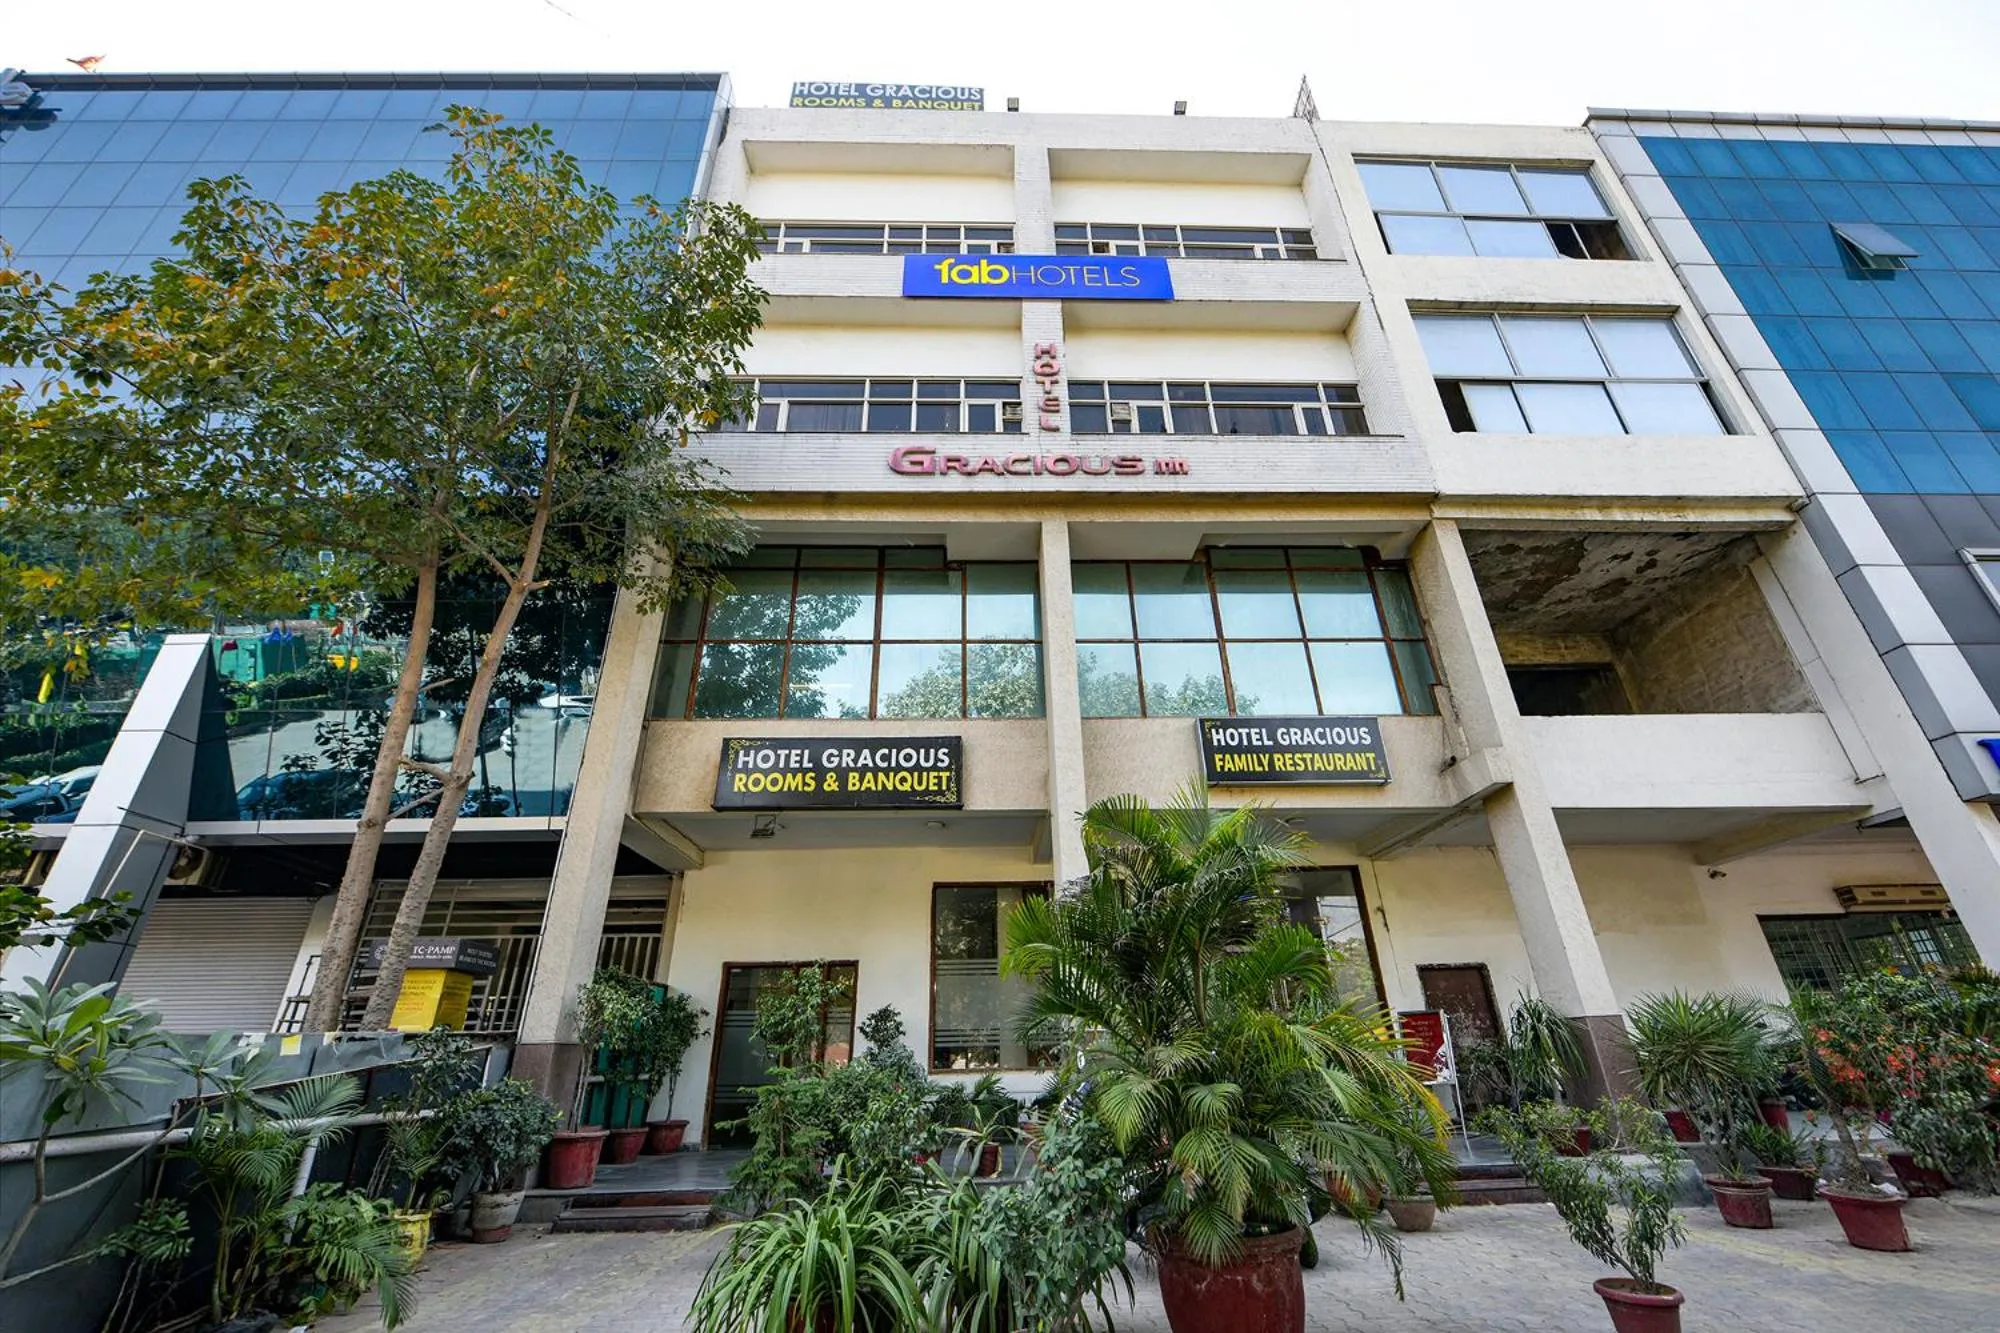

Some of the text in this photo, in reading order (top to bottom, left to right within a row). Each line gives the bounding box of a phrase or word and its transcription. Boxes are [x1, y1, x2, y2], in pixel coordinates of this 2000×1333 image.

[794, 82, 982, 100] HOTEL GRACIOUS
[792, 97, 982, 111] ROOMS & BANQUET
[1033, 342, 1060, 432] HOTEL
[1212, 727, 1371, 746] HOTEL GRACIOUS
[737, 748, 950, 769] HOTEL GRACIOUS
[1215, 752, 1376, 772] FAMILY RESTAURANT
[733, 771, 950, 792] ROOMS & BANQUET
